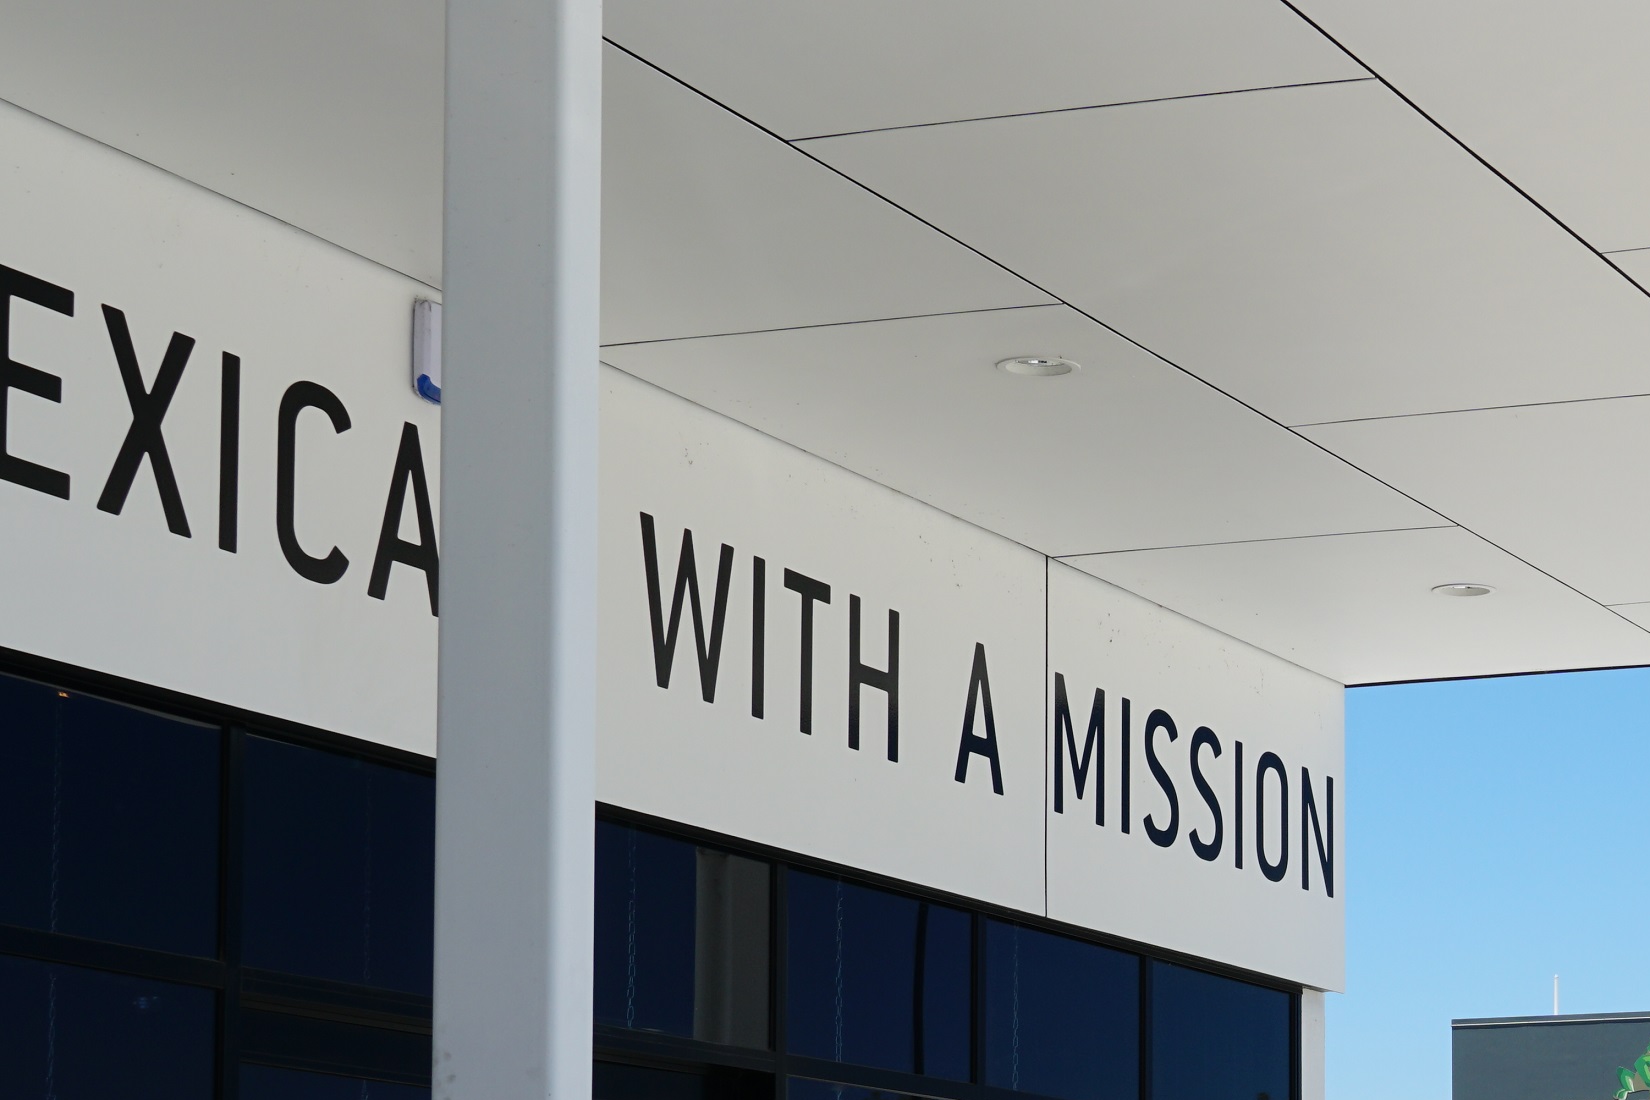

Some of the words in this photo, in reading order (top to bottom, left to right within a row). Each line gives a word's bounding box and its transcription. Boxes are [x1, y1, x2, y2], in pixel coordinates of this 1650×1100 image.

[640, 511, 900, 763] WITH
[954, 642, 1004, 796] A
[1054, 671, 1335, 899] MISSION
